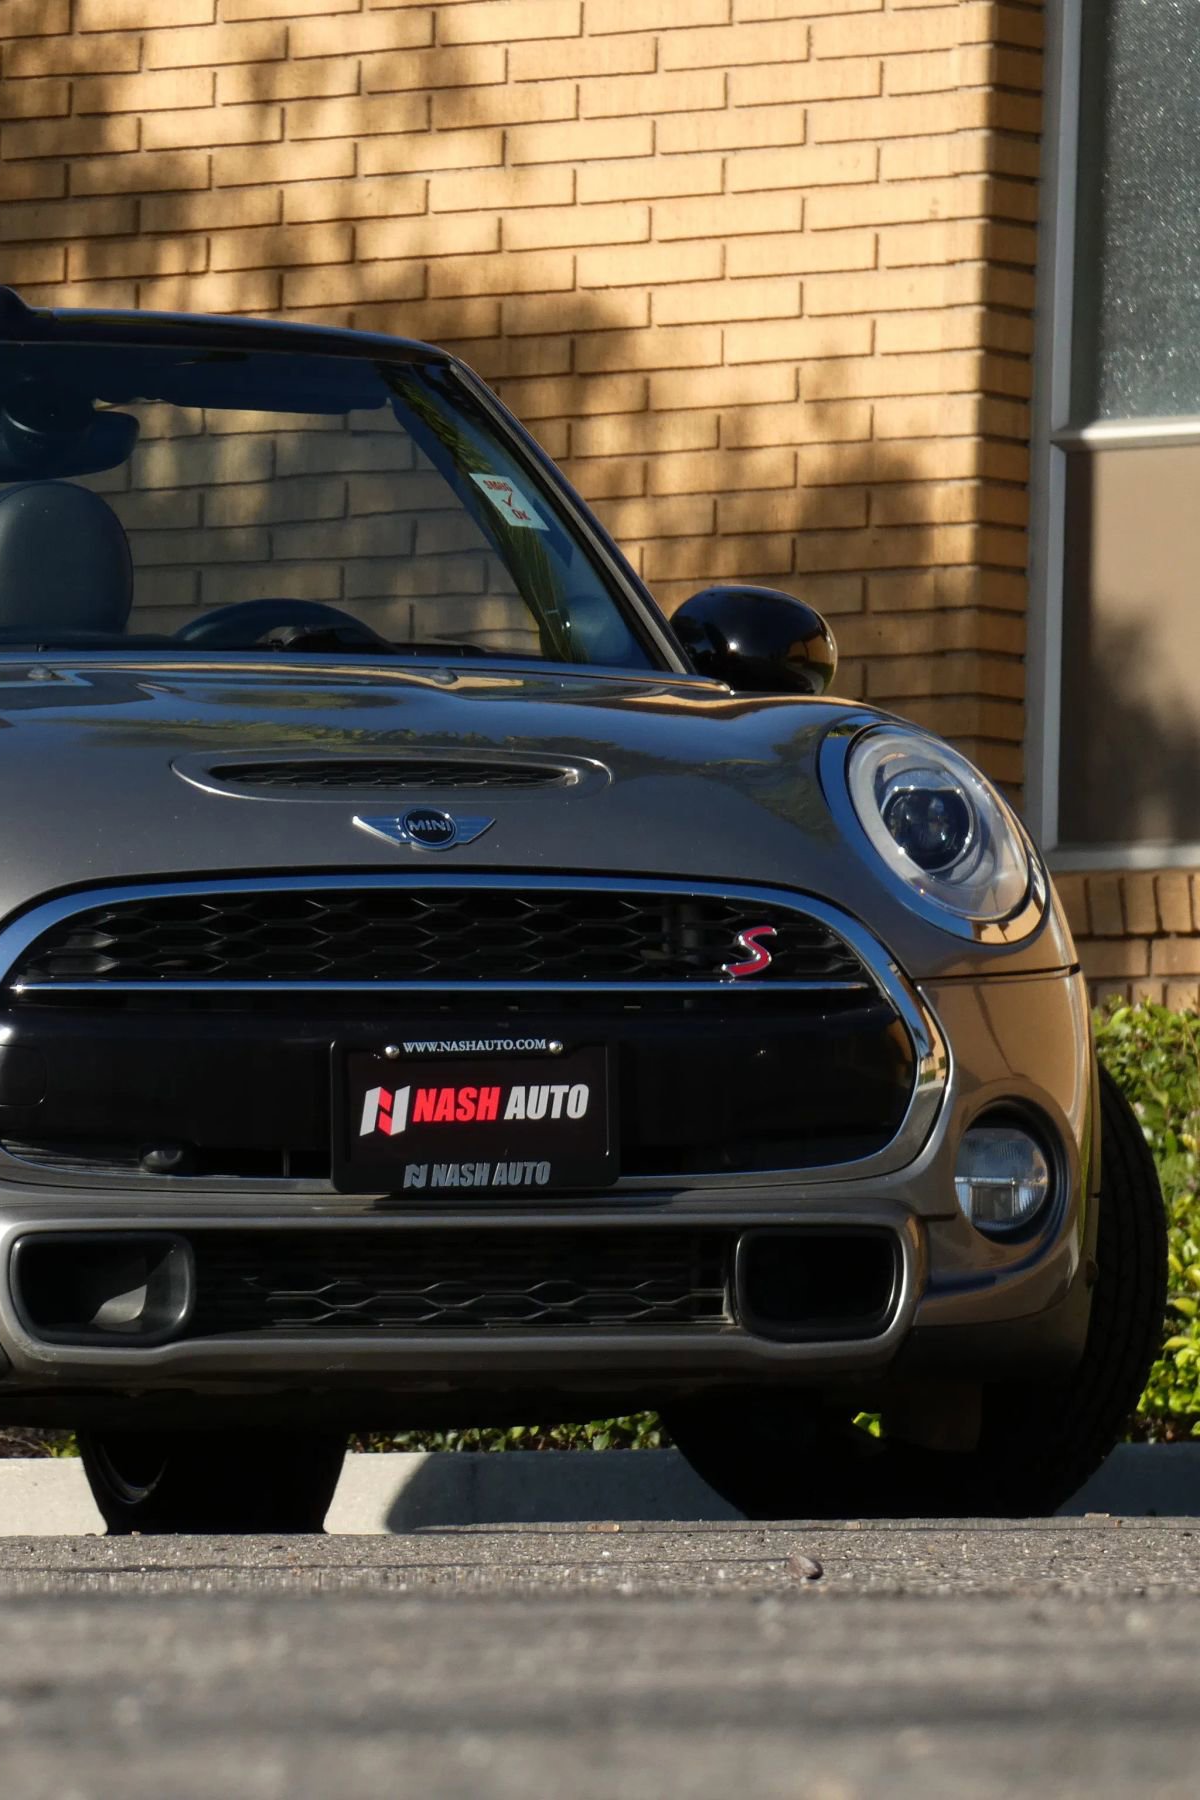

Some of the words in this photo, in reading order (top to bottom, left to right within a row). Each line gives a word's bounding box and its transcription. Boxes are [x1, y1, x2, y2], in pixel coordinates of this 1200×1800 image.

[407, 819, 451, 831] MINI
[721, 925, 777, 977] S
[402, 1039, 547, 1053] WWW.NASHAUTO.COM
[412, 1087, 501, 1122] NASH
[503, 1083, 590, 1120] AUTO
[430, 1162, 489, 1187] NASH
[491, 1161, 551, 1185] AUTO
